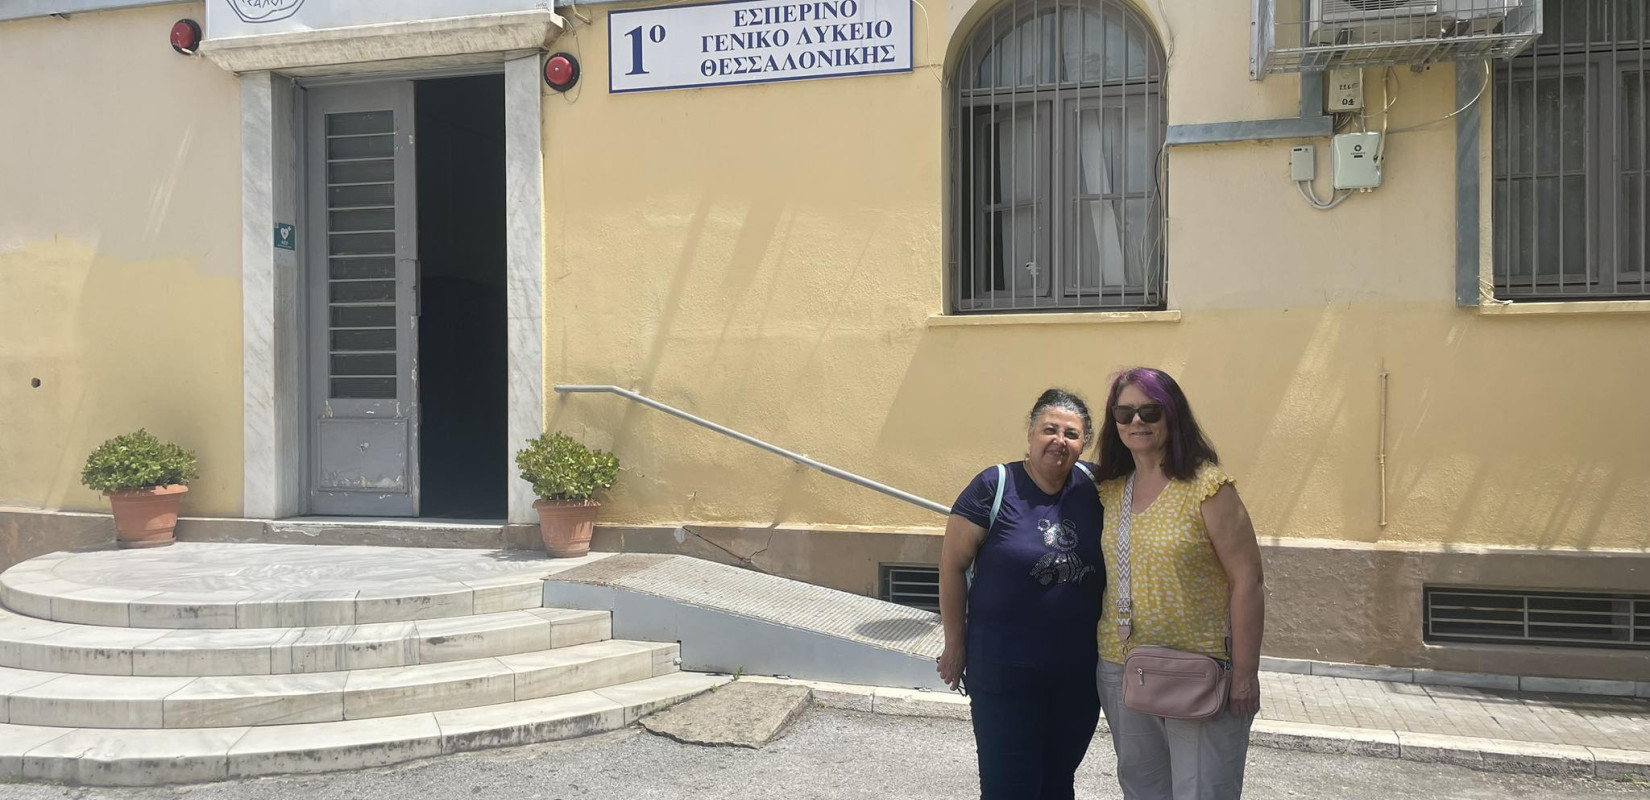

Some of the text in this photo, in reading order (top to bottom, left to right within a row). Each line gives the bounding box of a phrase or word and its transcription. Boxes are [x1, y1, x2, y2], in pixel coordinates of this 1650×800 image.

[734, 0, 858, 28] ΕΣΠΕΡΙΝΟ
[701, 19, 893, 53] ΓΕΝΙΚΟ ΛΥΚΕΙΟ
[700, 44, 896, 77] ΘΕΣΣΑΛΟΝΙΚΗΣ
